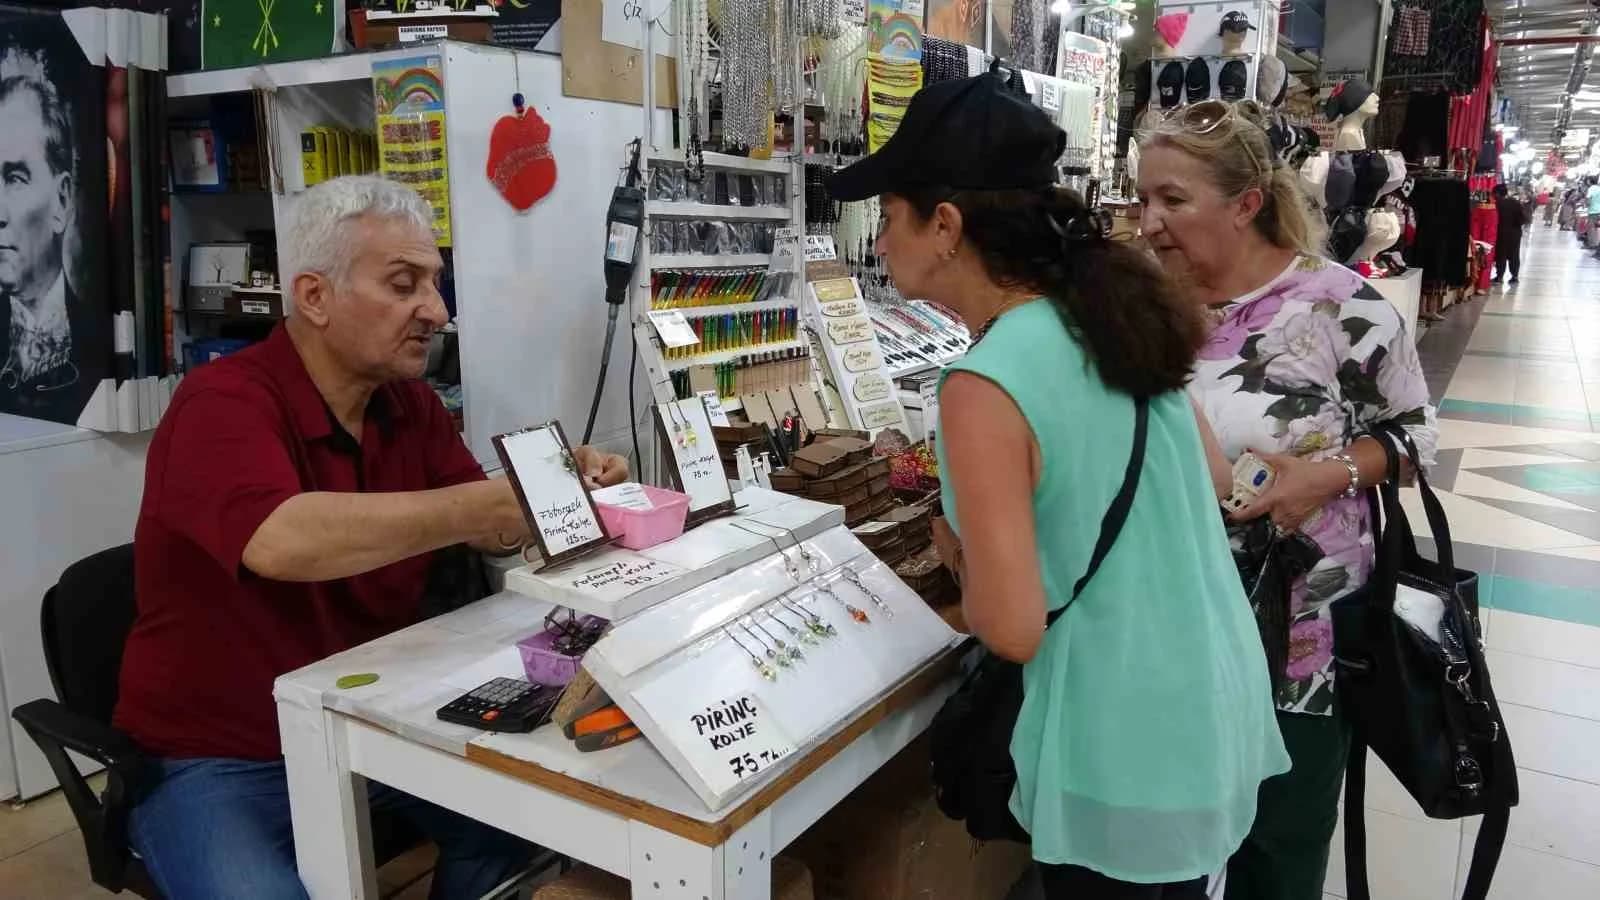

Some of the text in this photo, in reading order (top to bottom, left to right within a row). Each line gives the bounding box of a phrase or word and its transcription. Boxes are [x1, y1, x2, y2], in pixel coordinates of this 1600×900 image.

[690, 697, 757, 736] PİRİNÇ
[709, 722, 757, 750] KOLYE
[728, 752, 759, 779] 75
